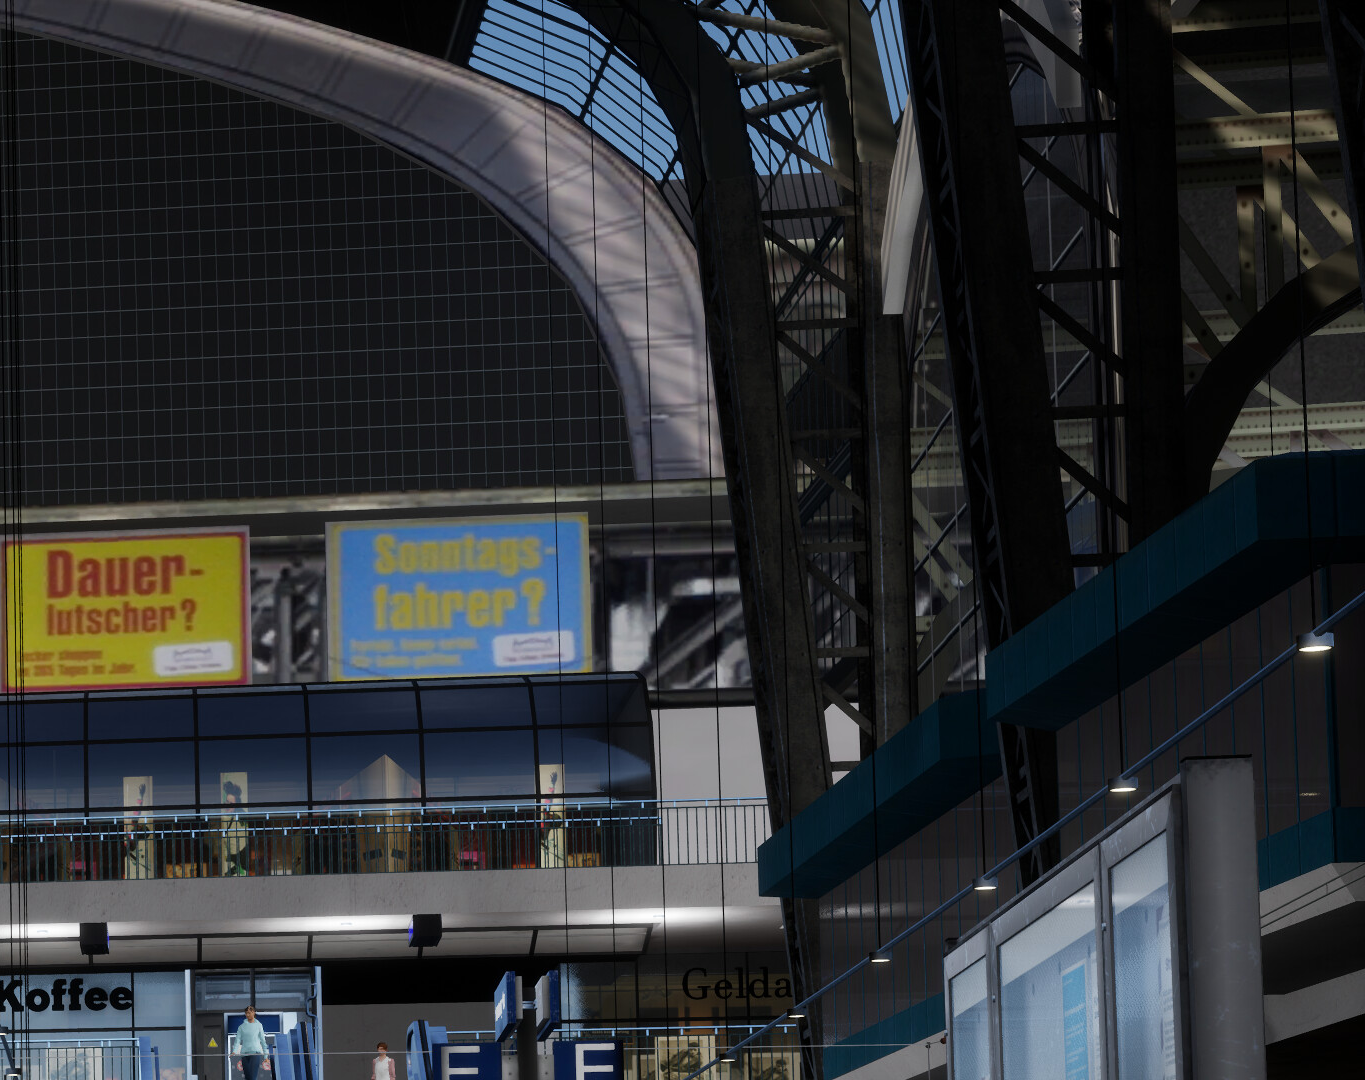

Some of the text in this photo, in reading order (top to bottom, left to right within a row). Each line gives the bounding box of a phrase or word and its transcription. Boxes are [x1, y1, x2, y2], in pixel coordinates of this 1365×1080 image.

[46, 549, 205, 599] Dauer-
[374, 532, 556, 577] Sonntags-
[46, 598, 197, 637] lutscher?
[374, 577, 546, 631] fahrer?
